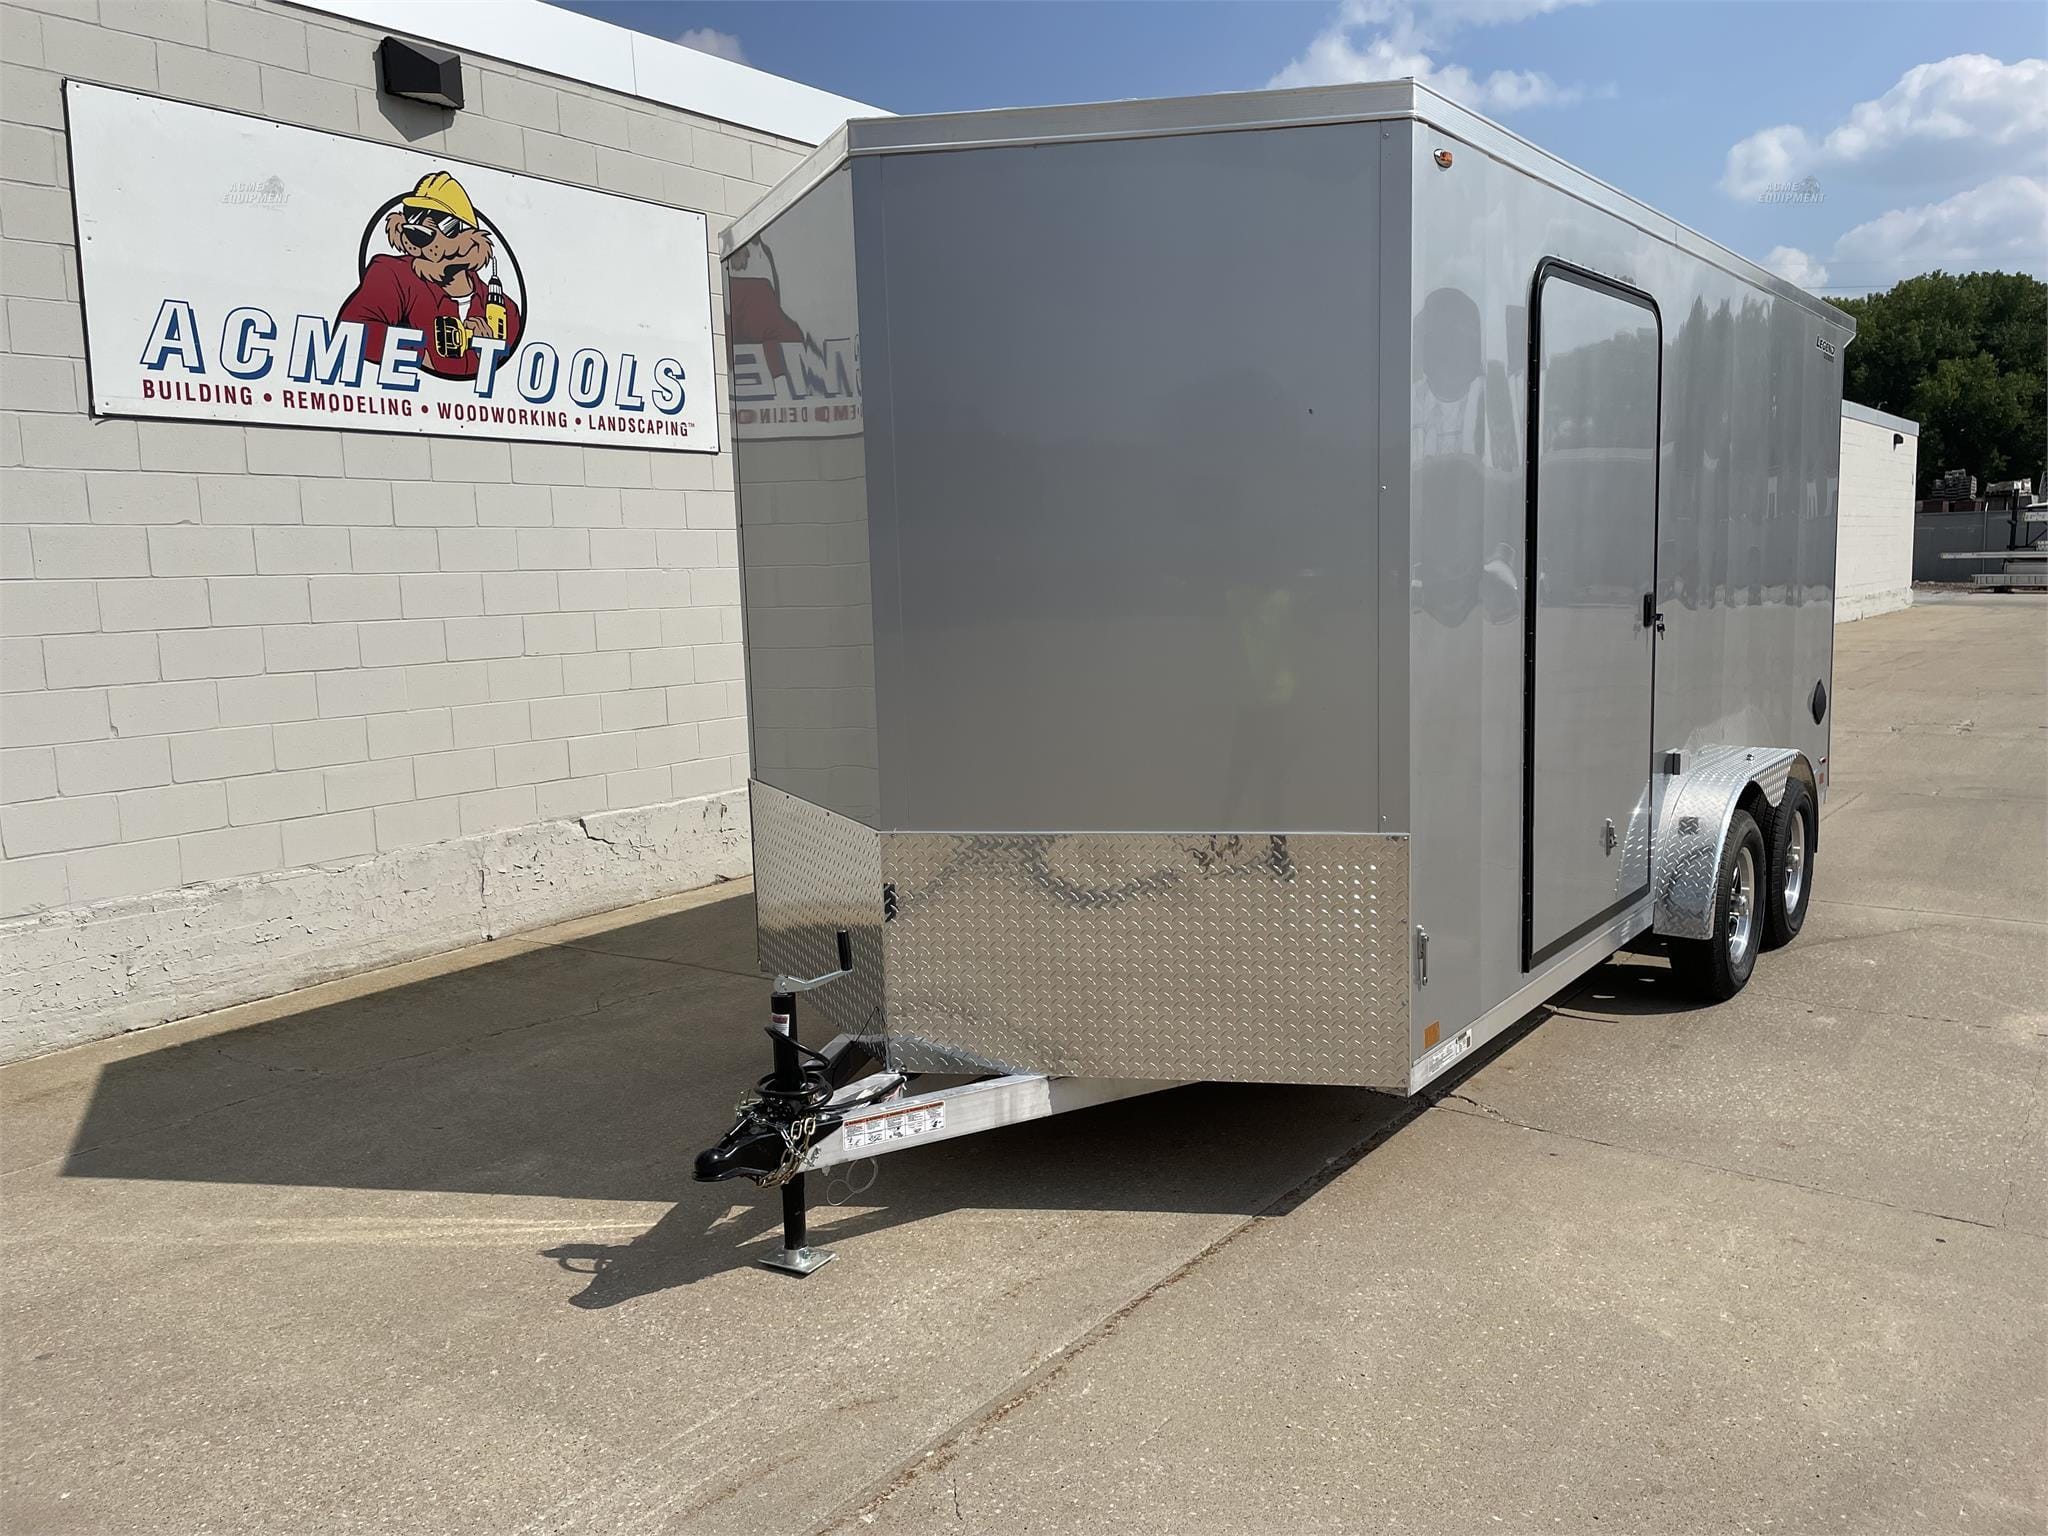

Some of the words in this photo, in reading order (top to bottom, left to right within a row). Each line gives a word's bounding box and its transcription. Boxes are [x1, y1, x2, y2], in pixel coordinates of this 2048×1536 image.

[139, 299, 427, 392] ACME
[471, 336, 686, 415] TOOLS
[142, 379, 252, 405] BUILDING
[283, 390, 412, 416] REMODELING
[437, 402, 568, 428] WOODWORKING
